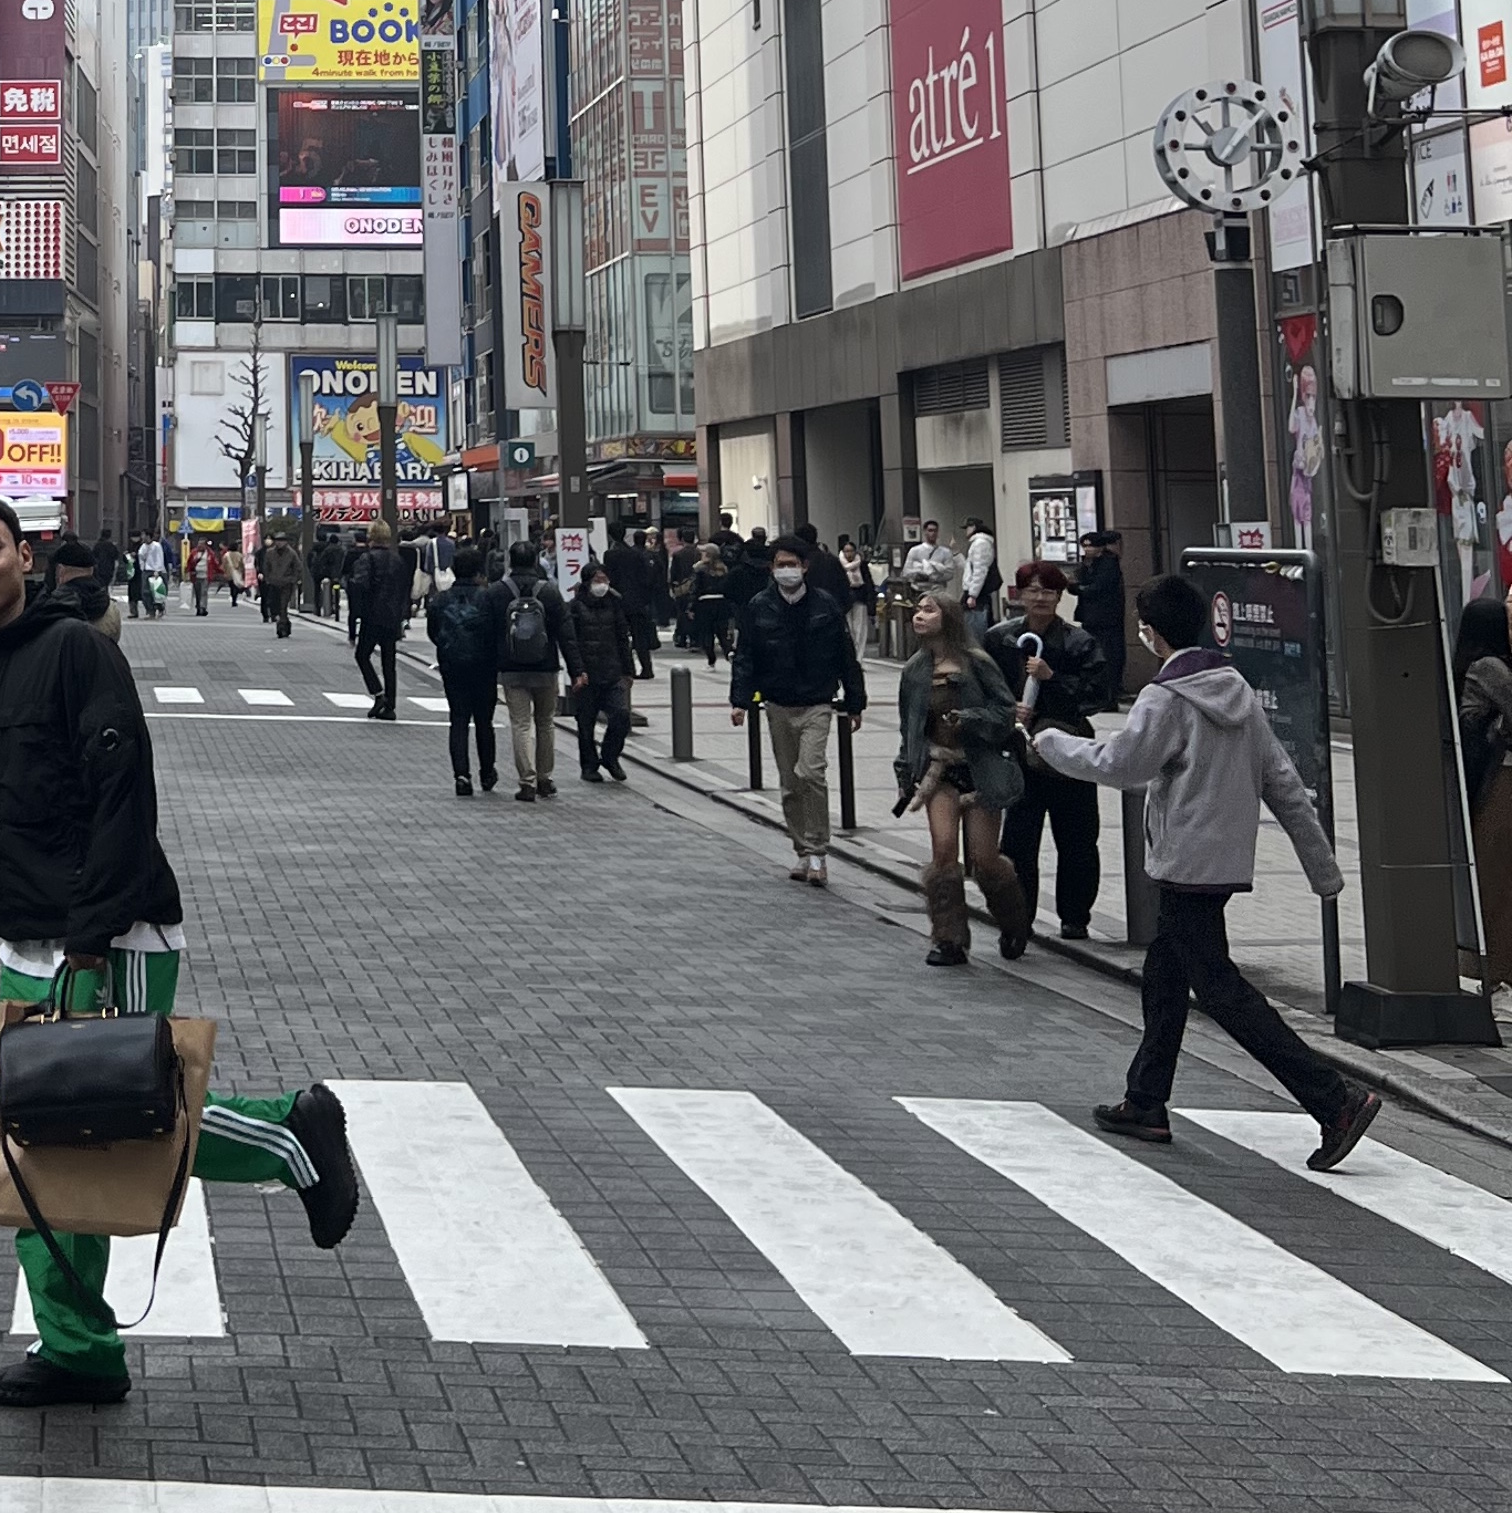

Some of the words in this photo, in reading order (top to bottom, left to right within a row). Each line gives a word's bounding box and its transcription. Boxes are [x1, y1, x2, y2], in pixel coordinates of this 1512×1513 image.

[355, 67, 377, 77] walk
[380, 68, 403, 77] from
[3, 87, 56, 112] 免税
[908, 26, 981, 165] atré
[1, 134, 56, 154] 면세점
[345, 217, 424, 235] ONODEN
[517, 191, 548, 398] GAMERS
[299, 370, 437, 395] ONOEN
[7, 443, 62, 464] OFF!!
